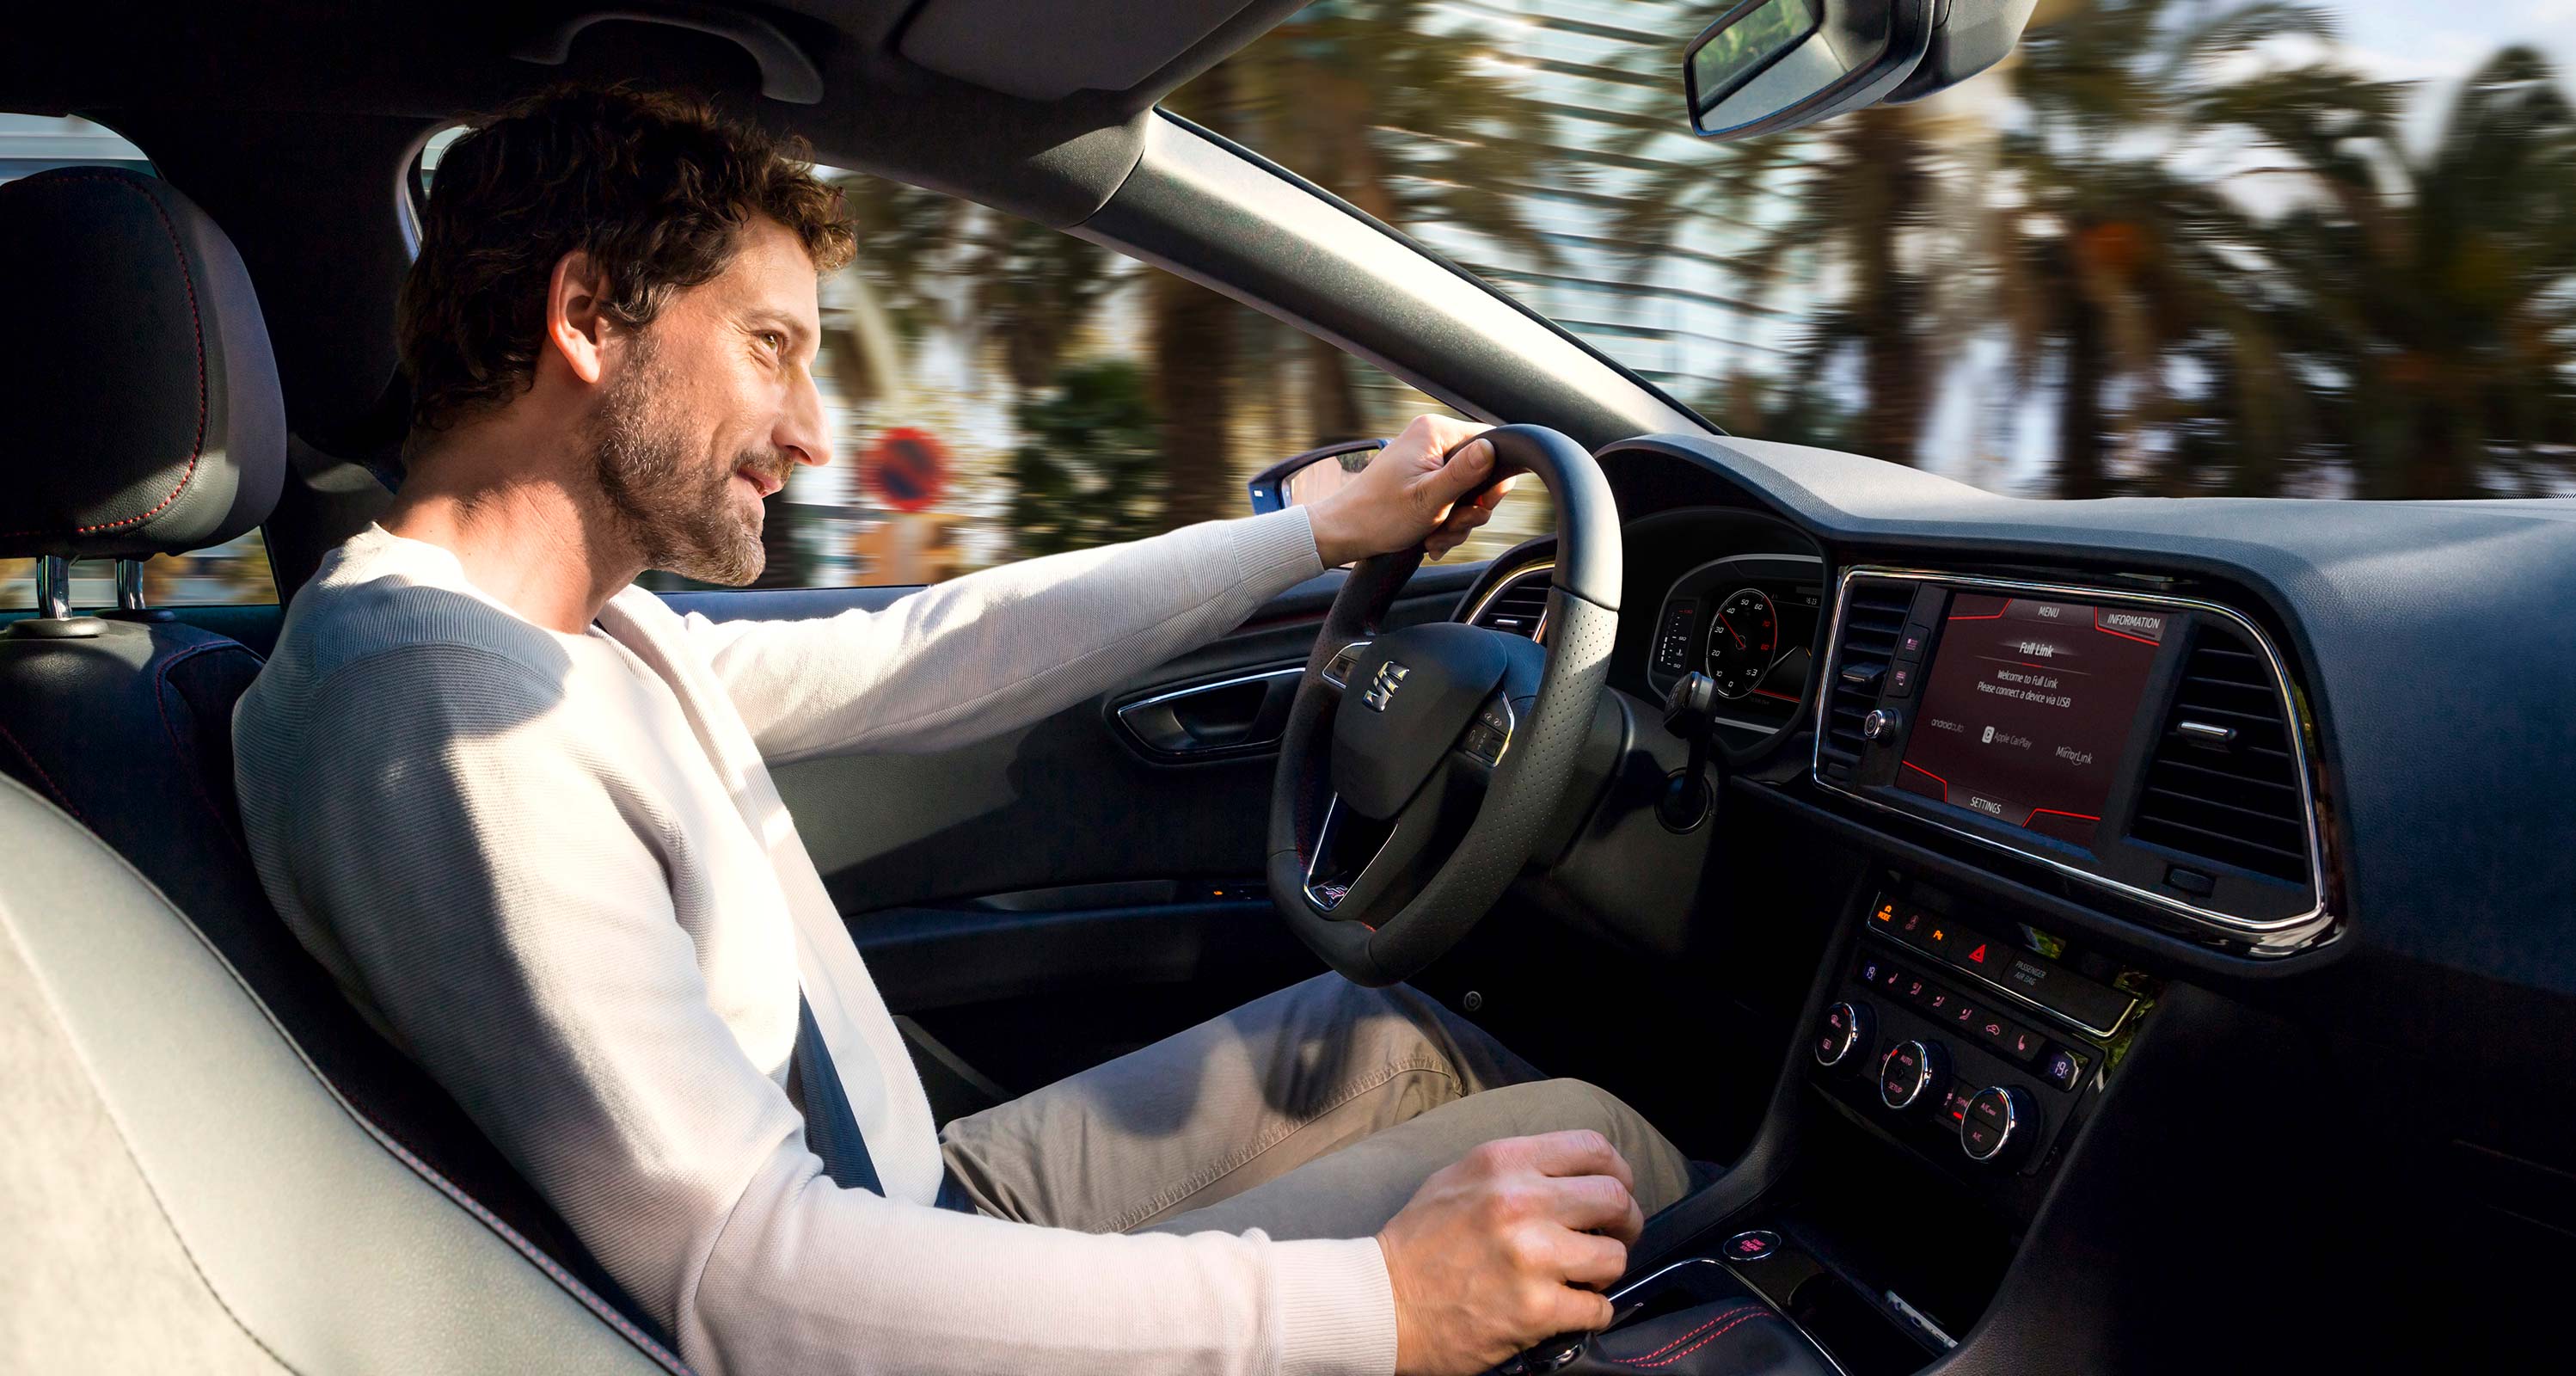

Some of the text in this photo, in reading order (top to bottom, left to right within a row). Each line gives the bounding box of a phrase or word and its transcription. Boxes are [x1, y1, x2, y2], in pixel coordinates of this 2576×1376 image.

[2038, 605, 2060, 618] MENU
[2107, 613, 2161, 630] INFORMATION
[2019, 642, 2054, 658] Full Link
[1997, 669, 2058, 689] Welcome to Full Link
[1977, 681, 1996, 693] Please
[1996, 686, 2020, 698] connect
[2025, 690, 2045, 703] device
[2045, 693, 2056, 705] via
[2056, 696, 2071, 708] USB
[1994, 732, 2033, 751] Apple CarPlay
[2056, 746, 2093, 765] MirrorLink
[1970, 796, 2002, 814] SETTINGS
[2015, 961, 2046, 978] PASSENGER
[2014, 971, 2037, 986] AIR BAG
[1899, 1054, 1913, 1066] AUTO
[1887, 1081, 1904, 1094] SETUP
